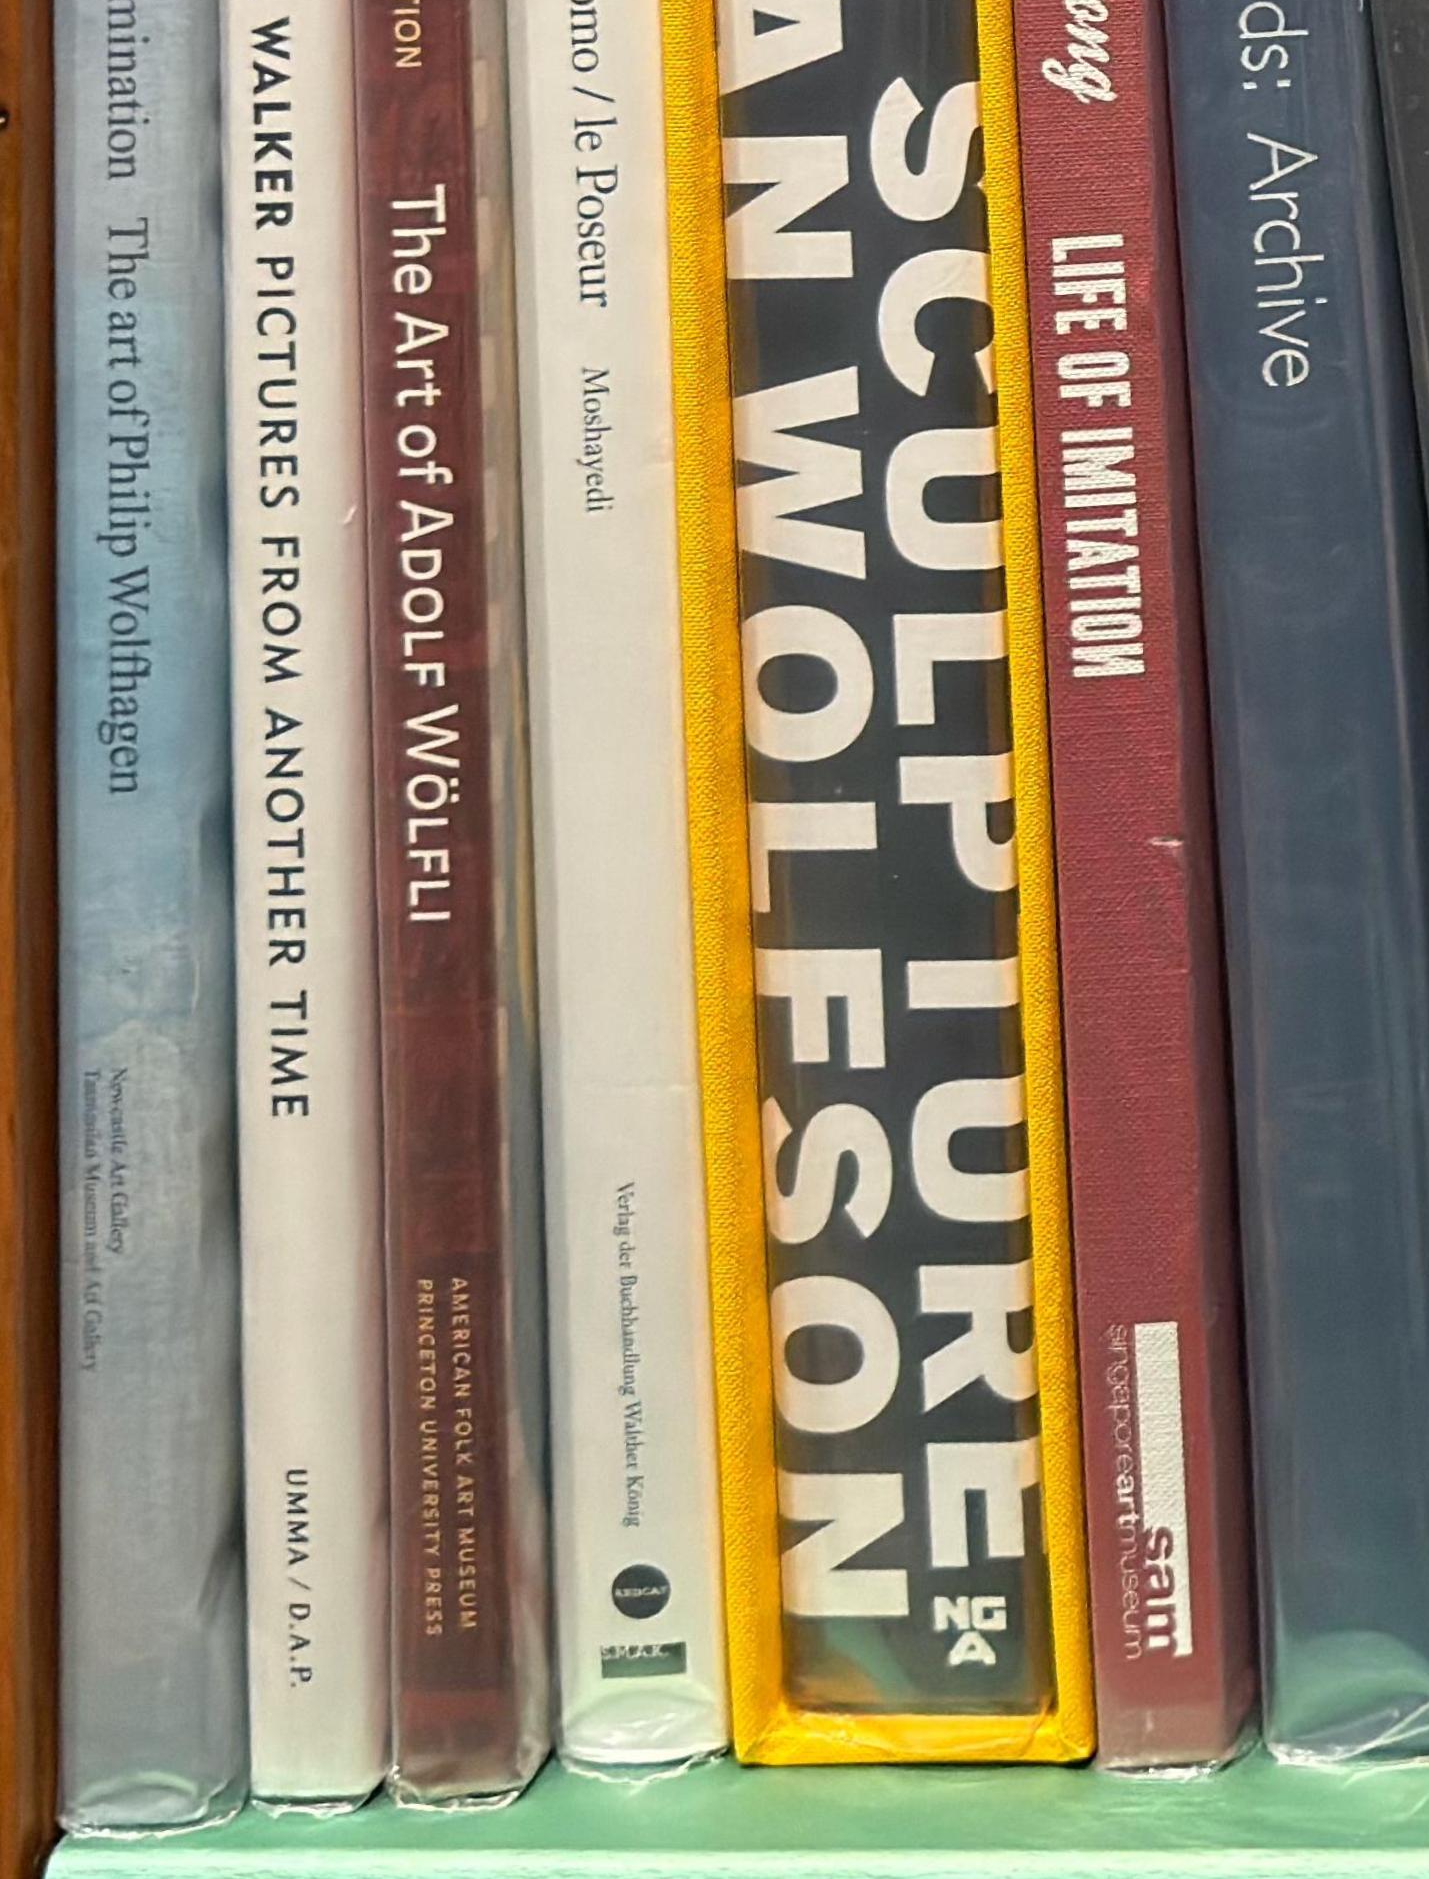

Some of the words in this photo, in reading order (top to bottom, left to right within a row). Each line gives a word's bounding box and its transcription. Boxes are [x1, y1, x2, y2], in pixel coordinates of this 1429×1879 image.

[249, 15, 294, 231] WALKER
[573, 116, 619, 152] le
[105, 216, 151, 301] The
[390, 182, 447, 296] The
[574, 164, 620, 309] Poseur
[1048, 231, 1128, 344] LIFE
[1245, 131, 1329, 388] Archive
[106, 310, 143, 366] art
[107, 374, 152, 426] of
[254, 255, 300, 510] PICTURES
[392, 311, 450, 408] Art
[1056, 351, 1130, 413] OF
[97, 429, 152, 559] Philip
[395, 423, 454, 485] of
[575, 367, 615, 514] Moshayedi
[260, 535, 302, 685] FROM
[398, 499, 455, 688] ADOLF
[1062, 424, 1146, 678] IMITATION
[94, 565, 152, 795] Wolfhagen
[263, 707, 307, 968] ANOTHER
[404, 703, 461, 922] WÖLFLI
[269, 988, 310, 1118] TIME
[735, 368, 909, 1624] WOLFSON
[416, 1278, 438, 1411] PRINCETON
[450, 1277, 473, 1399] AMERICAN
[418, 1419, 441, 1557] UNIVERSITY
[453, 1406, 474, 1466] FOLK
[455, 1474, 475, 1517] ART
[285, 1467, 310, 1567] UMMA
[457, 1526, 478, 1630] MUSEUM
[287, 1601, 313, 1689] D.A.P.
[424, 1566, 444, 1637] PRESS
